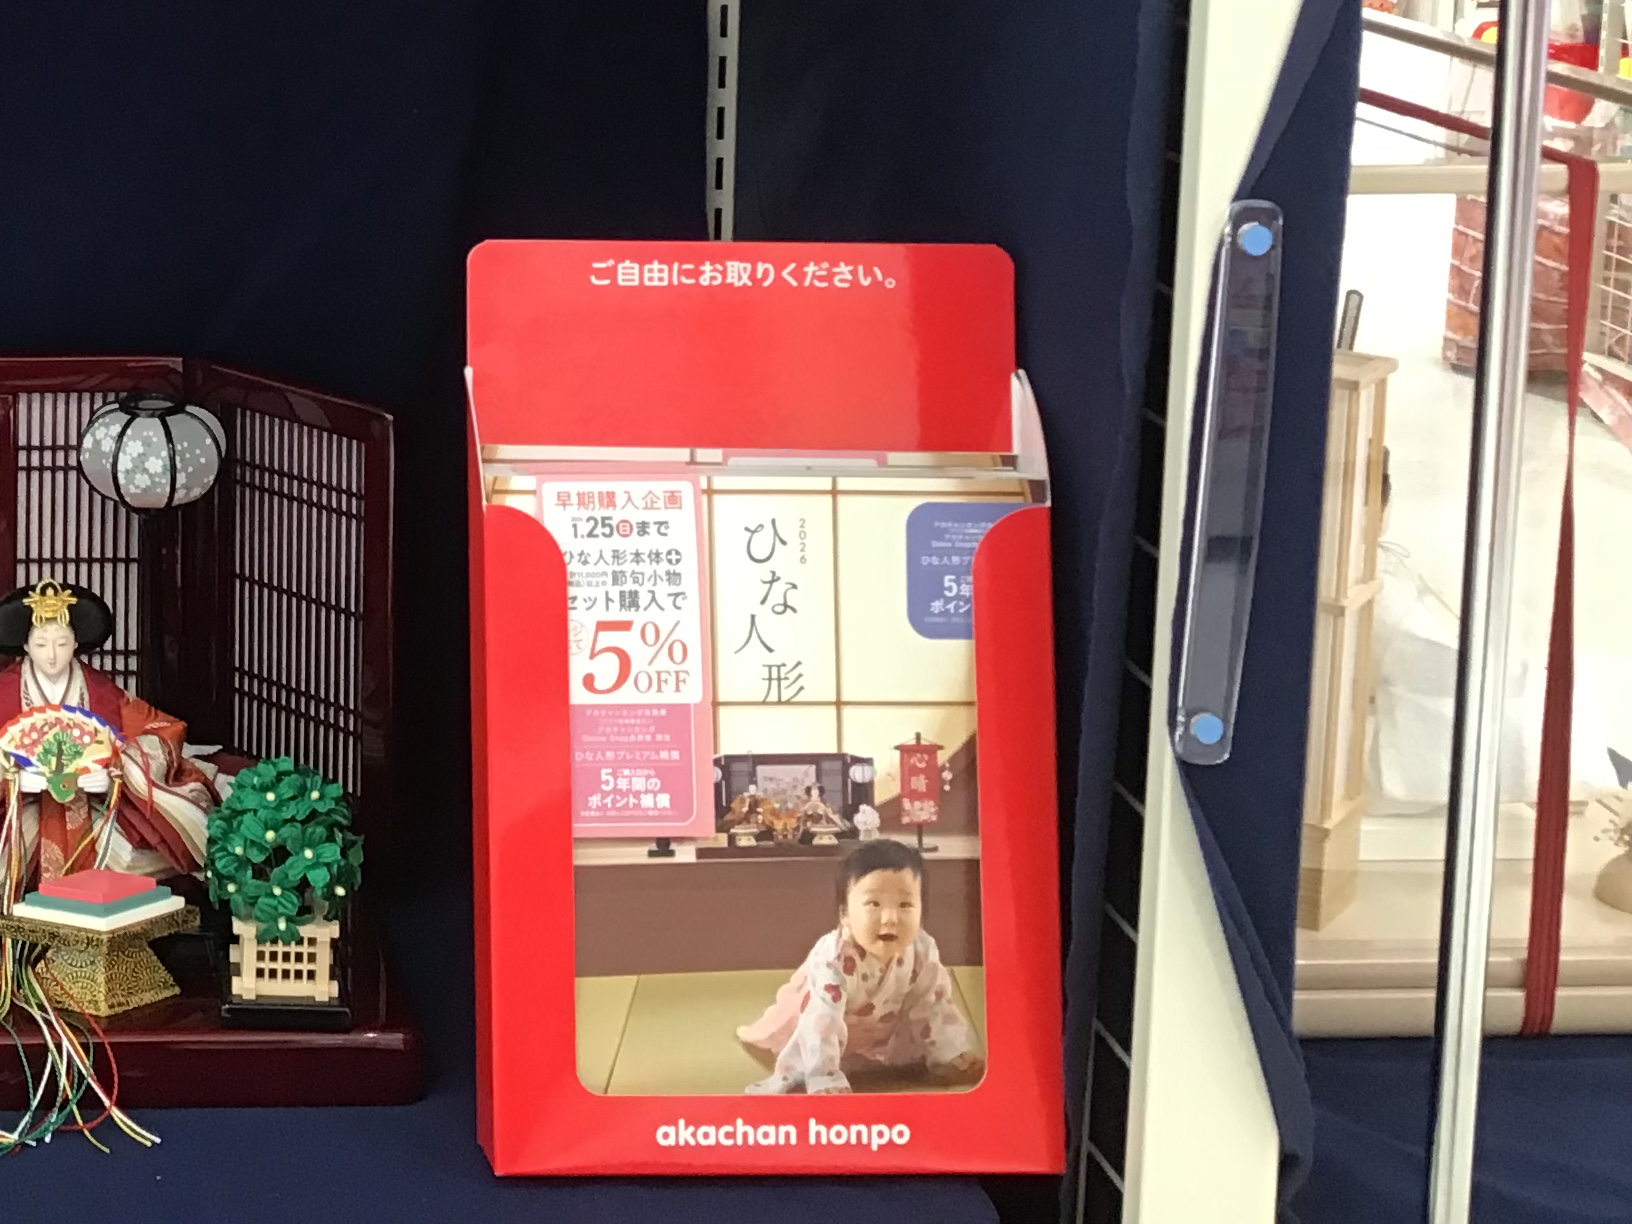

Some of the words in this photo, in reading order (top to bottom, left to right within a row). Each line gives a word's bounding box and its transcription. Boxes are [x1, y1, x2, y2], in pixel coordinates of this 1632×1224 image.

[588, 259, 897, 290] ご自由にお取りください。
[555, 489, 684, 512] 早期購入企画
[798, 518, 808, 565] 2026
[920, 555, 974, 567] ひな人形プ
[610, 570, 682, 588] 節句小物
[732, 517, 806, 703] ひな人形
[582, 619, 689, 696] 5%
[633, 669, 691, 695] OFF
[574, 750, 681, 762] ひな人形プレミアム補償
[600, 768, 662, 793] 5年間の
[587, 792, 672, 810] ポイント補償
[655, 1117, 798, 1148] akachan
[808, 1117, 911, 1152] honpo
